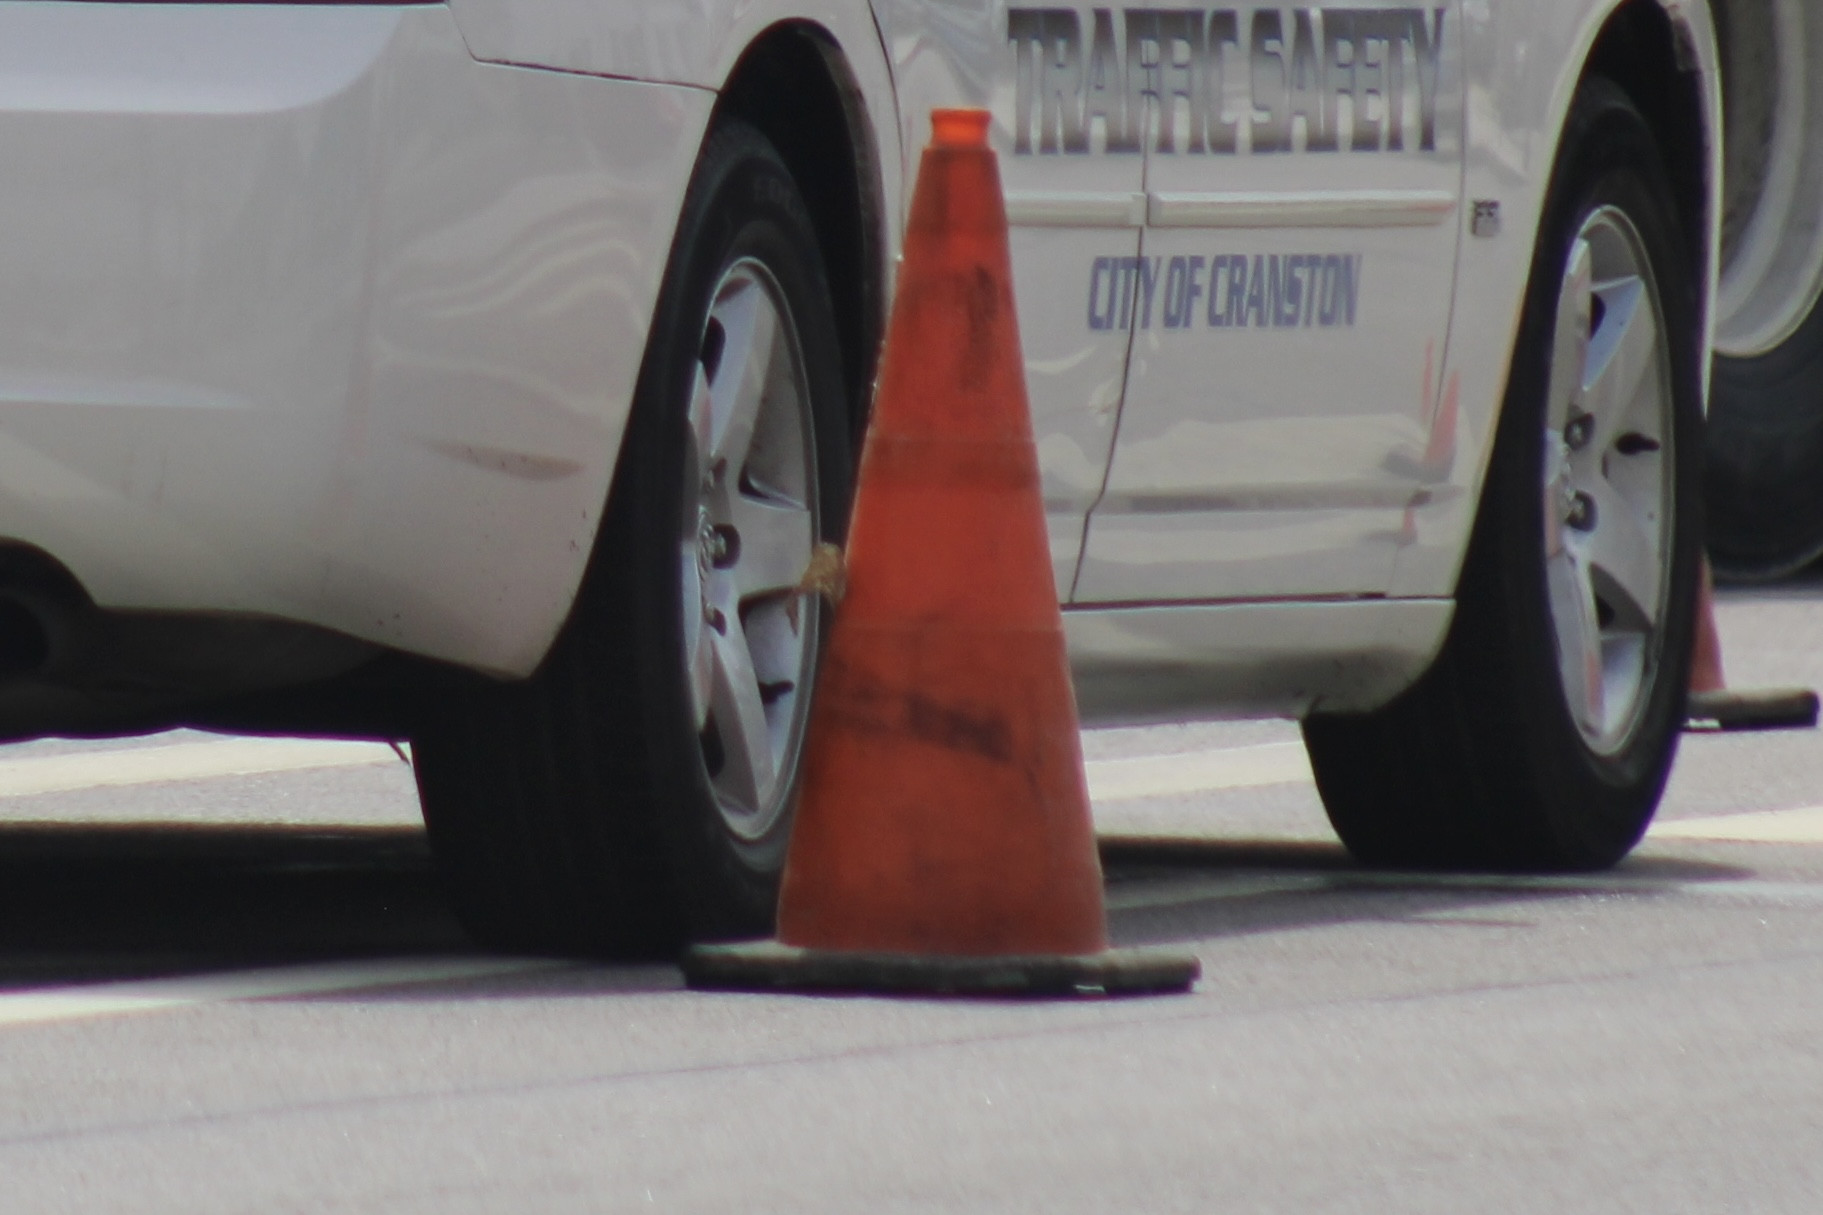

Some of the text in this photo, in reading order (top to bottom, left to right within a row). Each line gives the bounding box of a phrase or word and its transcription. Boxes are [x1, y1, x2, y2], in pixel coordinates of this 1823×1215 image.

[1007, 7, 1446, 155] TRAFFIC SAFETY
[1088, 253, 1363, 332] CITY OF CRANSTON
